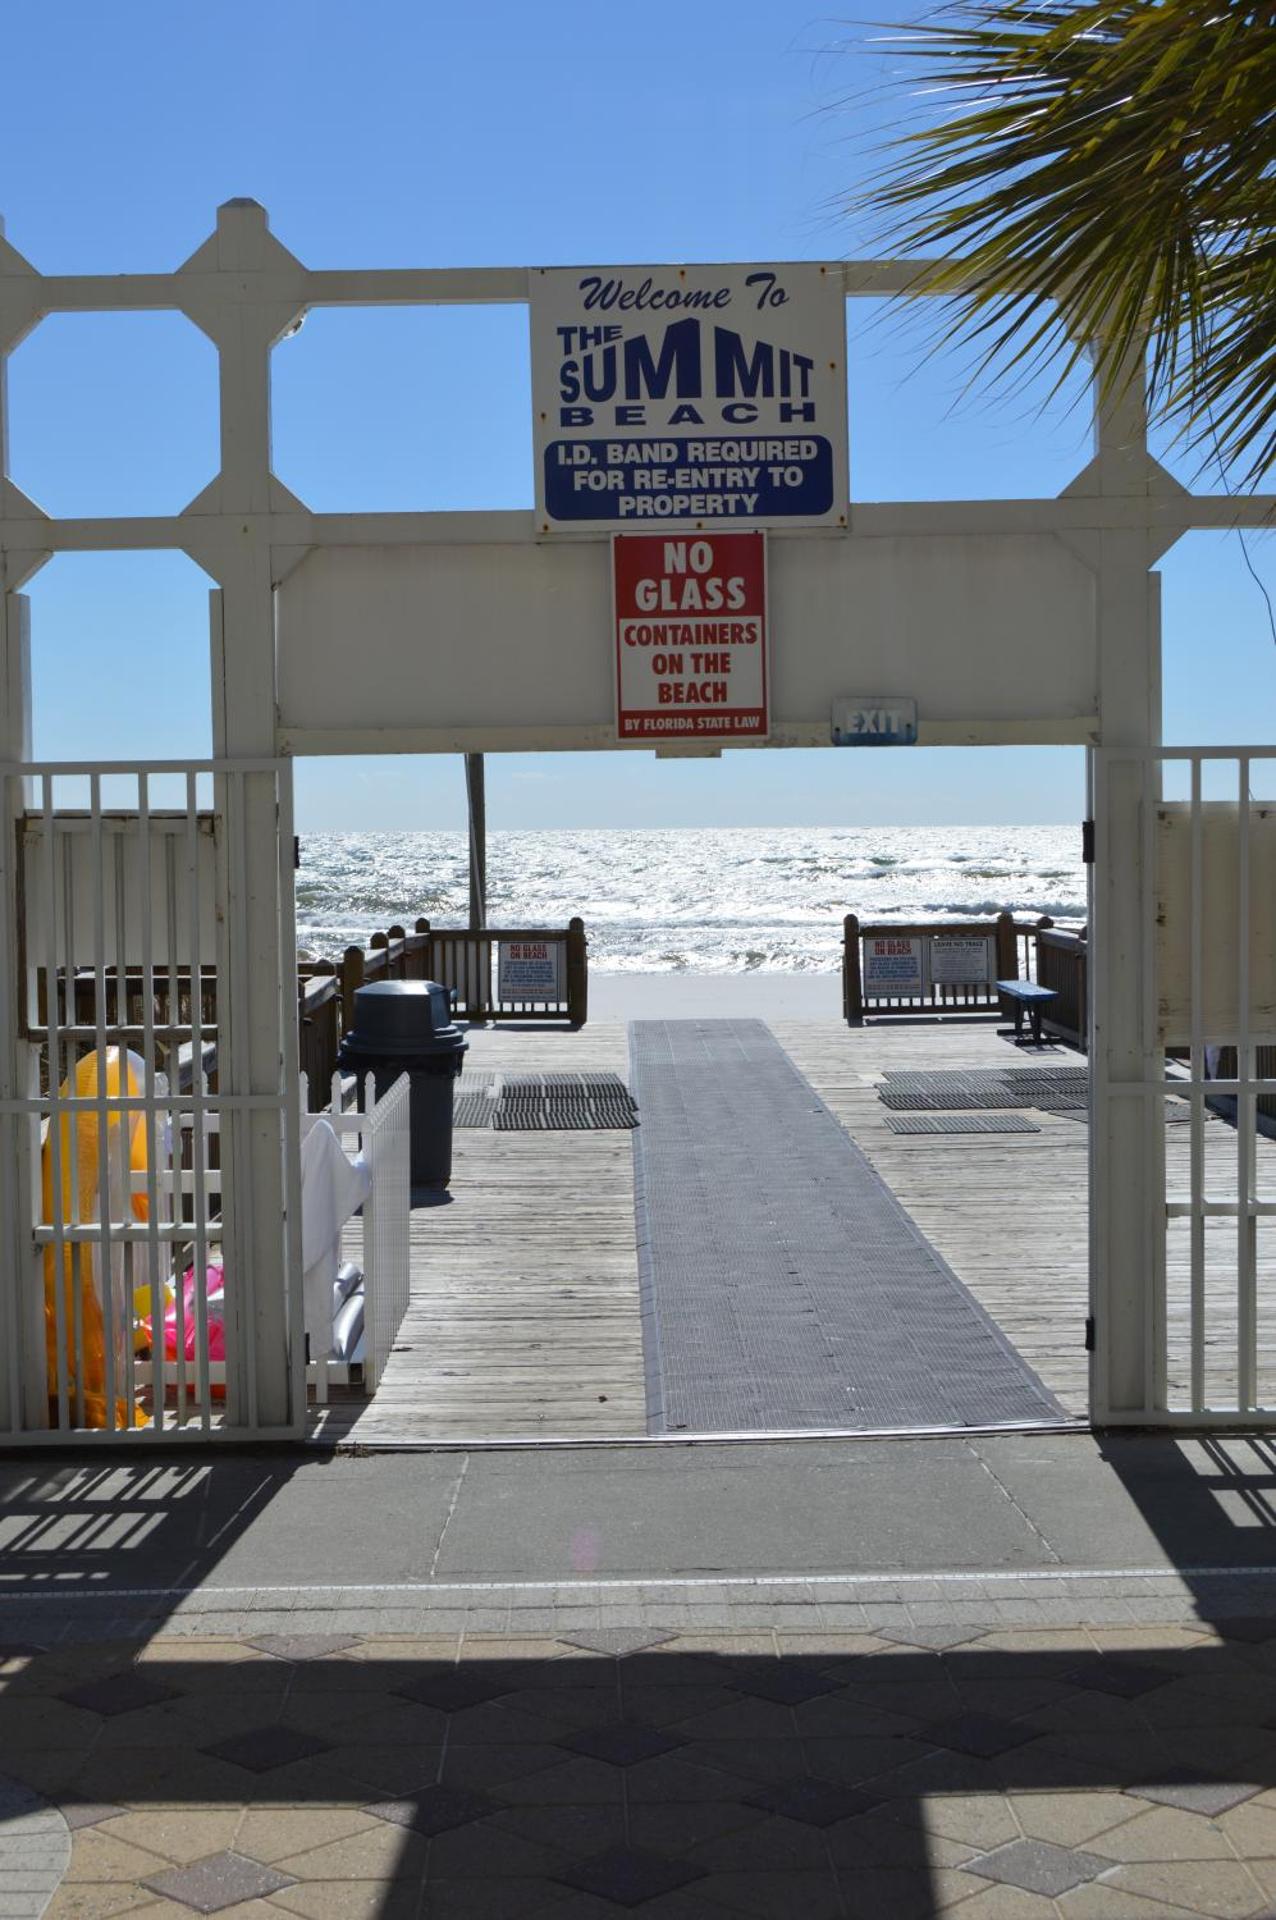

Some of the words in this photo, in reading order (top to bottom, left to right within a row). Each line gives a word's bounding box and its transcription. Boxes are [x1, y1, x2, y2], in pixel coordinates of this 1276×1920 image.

[579, 276, 732, 311] Welcome
[745, 272, 791, 311] To
[557, 325, 623, 356] THE
[560, 317, 814, 404] SUMMIT
[560, 402, 816, 427] BEACH
[557, 444, 597, 466] I.D.
[607, 442, 679, 464] BAND
[687, 440, 818, 464] REQUIRED
[573, 470, 625, 492] FOR
[634, 466, 761, 490] RE-ENTRY
[768, 466, 804, 488] TO
[619, 493, 760, 517] PROPERTY
[663, 541, 713, 574] NO
[635, 576, 746, 612] GLASS
[623, 622, 758, 647] CONTAINERS
[652, 653, 683, 675] ON
[690, 652, 731, 674] THE
[657, 681, 727, 704] BEACH
[624, 718, 641, 731] BY
[644, 717, 695, 731] FLORIDA
[696, 717, 731, 729] STATE
[734, 716, 760, 728] LAW
[846, 709, 902, 734] EXIT
[510, 944, 521, 952] NO
[874, 940, 885, 948] NO
